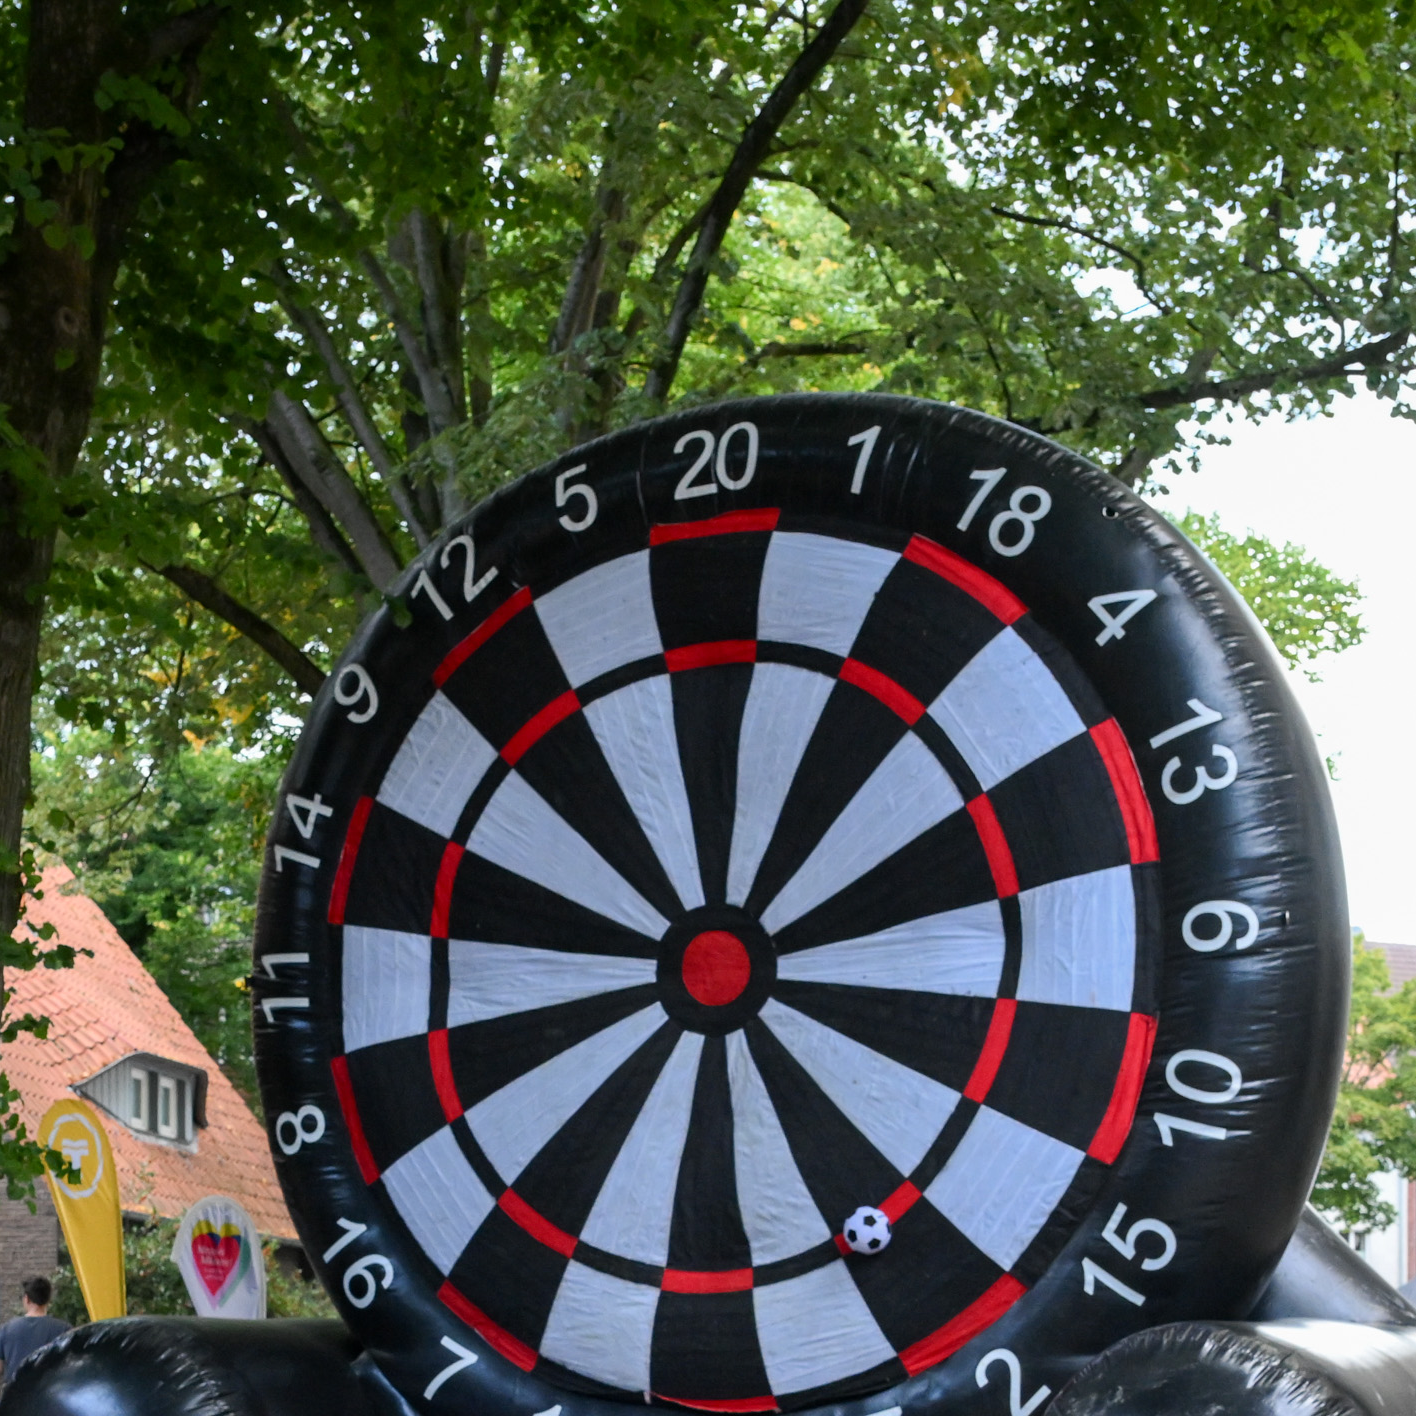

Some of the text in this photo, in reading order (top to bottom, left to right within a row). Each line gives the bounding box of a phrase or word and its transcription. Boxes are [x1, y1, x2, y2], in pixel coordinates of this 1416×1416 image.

[674, 422, 758, 500] 20
[848, 426, 881, 494] 1
[556, 464, 597, 531] 5
[957, 468, 1051, 557] 18
[410, 535, 498, 620] 12
[1088, 589, 1158, 646] 4
[333, 662, 378, 723] 9
[1150, 699, 1239, 806] 13
[274, 794, 333, 872] 14
[1182, 898, 1261, 951] 6
[262, 953, 309, 1023] 11
[276, 1105, 325, 1155] 8
[1154, 1050, 1242, 1146] 10
[321, 1218, 394, 1310] 16
[1082, 1203, 1176, 1306] 15
[424, 1336, 479, 1399] 7
